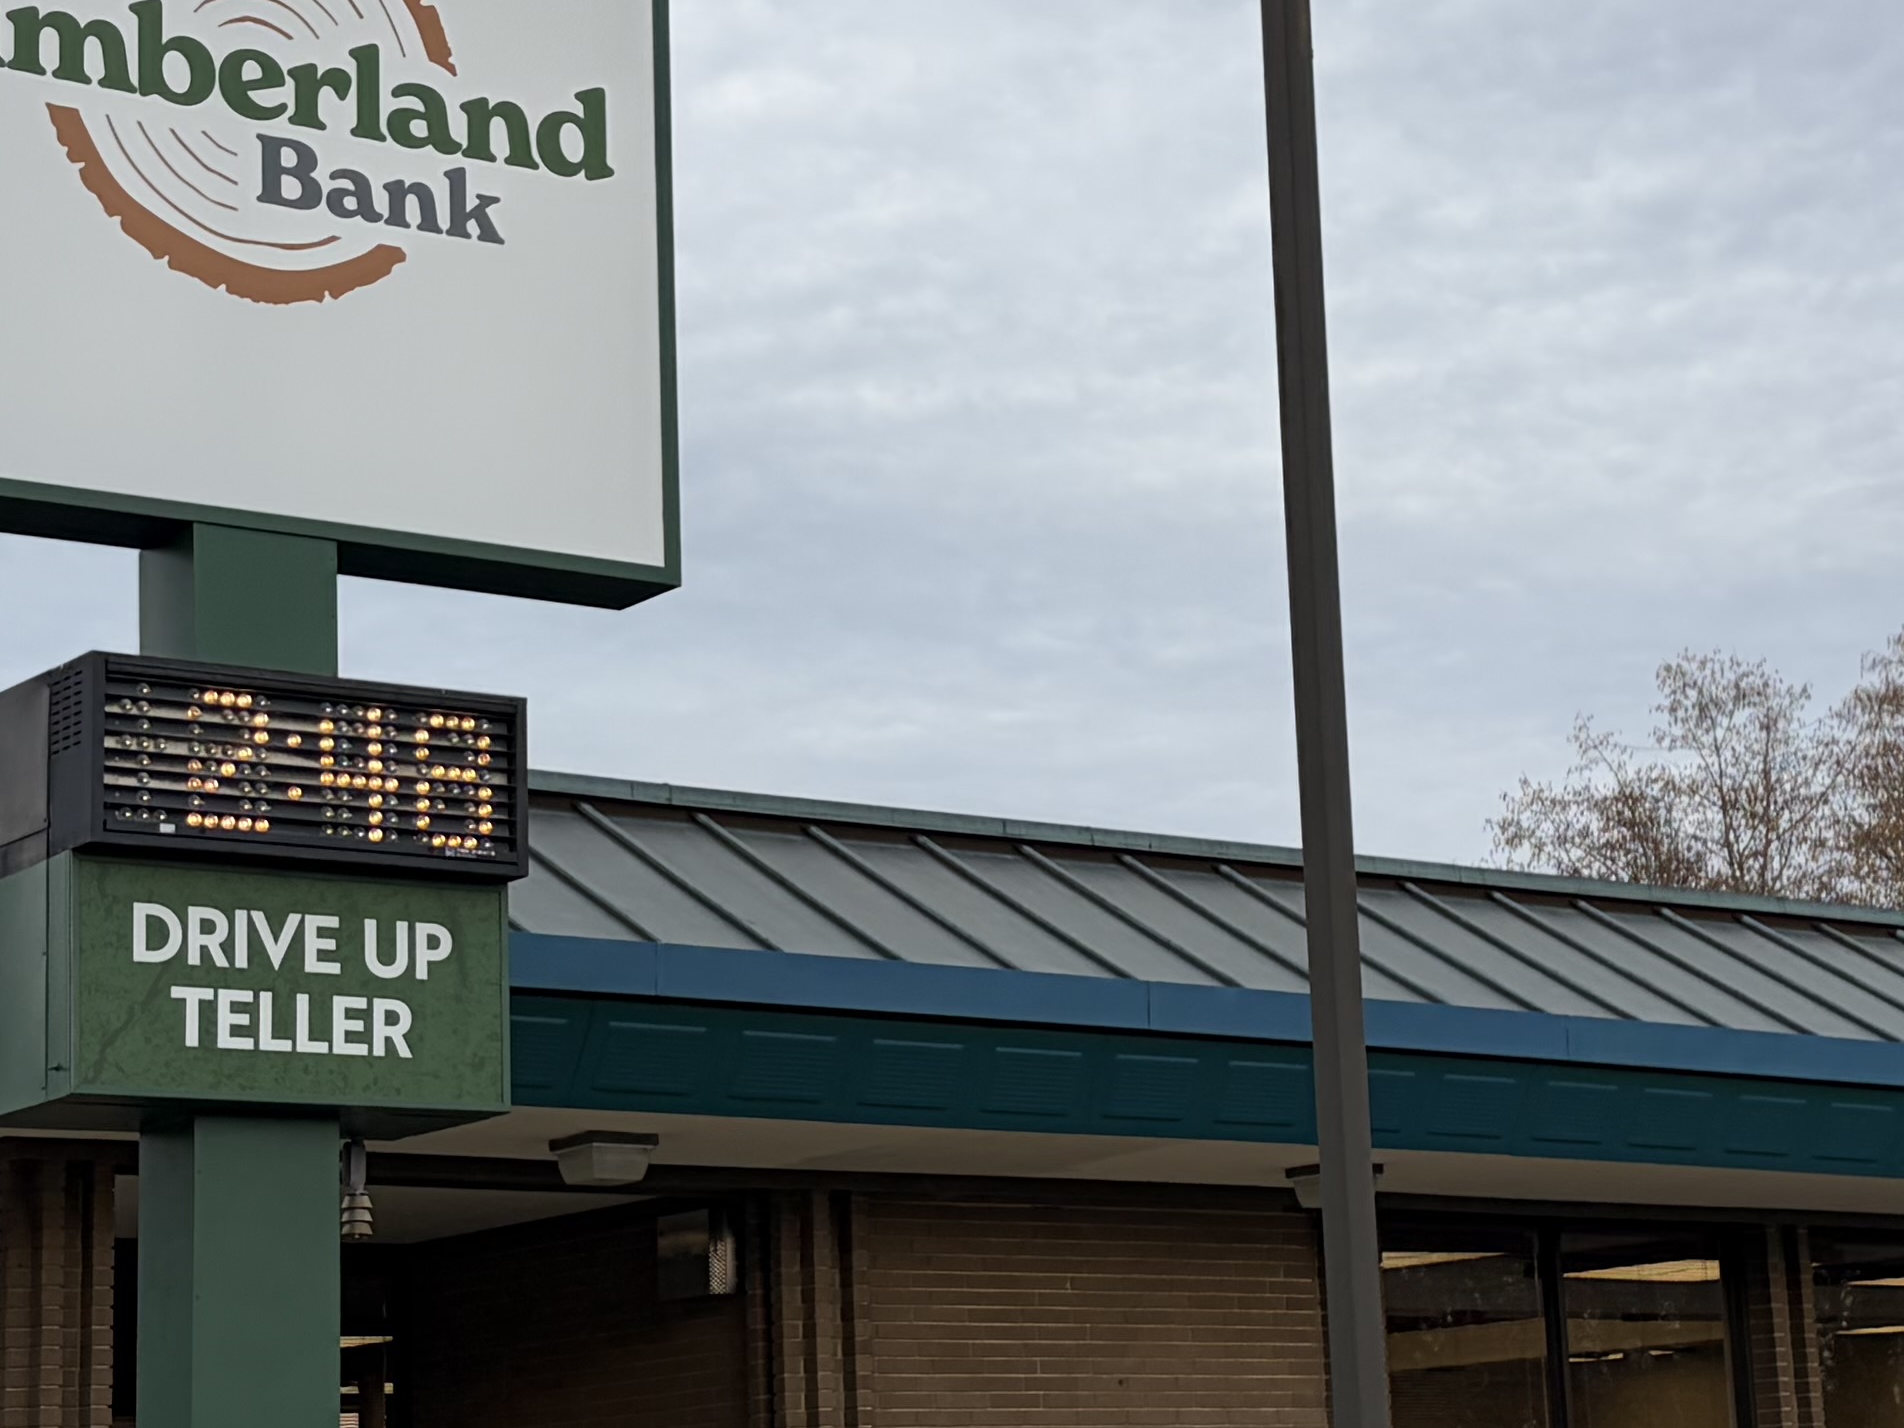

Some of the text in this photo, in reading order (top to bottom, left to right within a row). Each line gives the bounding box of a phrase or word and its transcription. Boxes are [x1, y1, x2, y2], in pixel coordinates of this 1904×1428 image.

[256, 133, 505, 245] Bank
[132, 901, 454, 980] DRIVE UP
[170, 986, 414, 1059] TELLER
